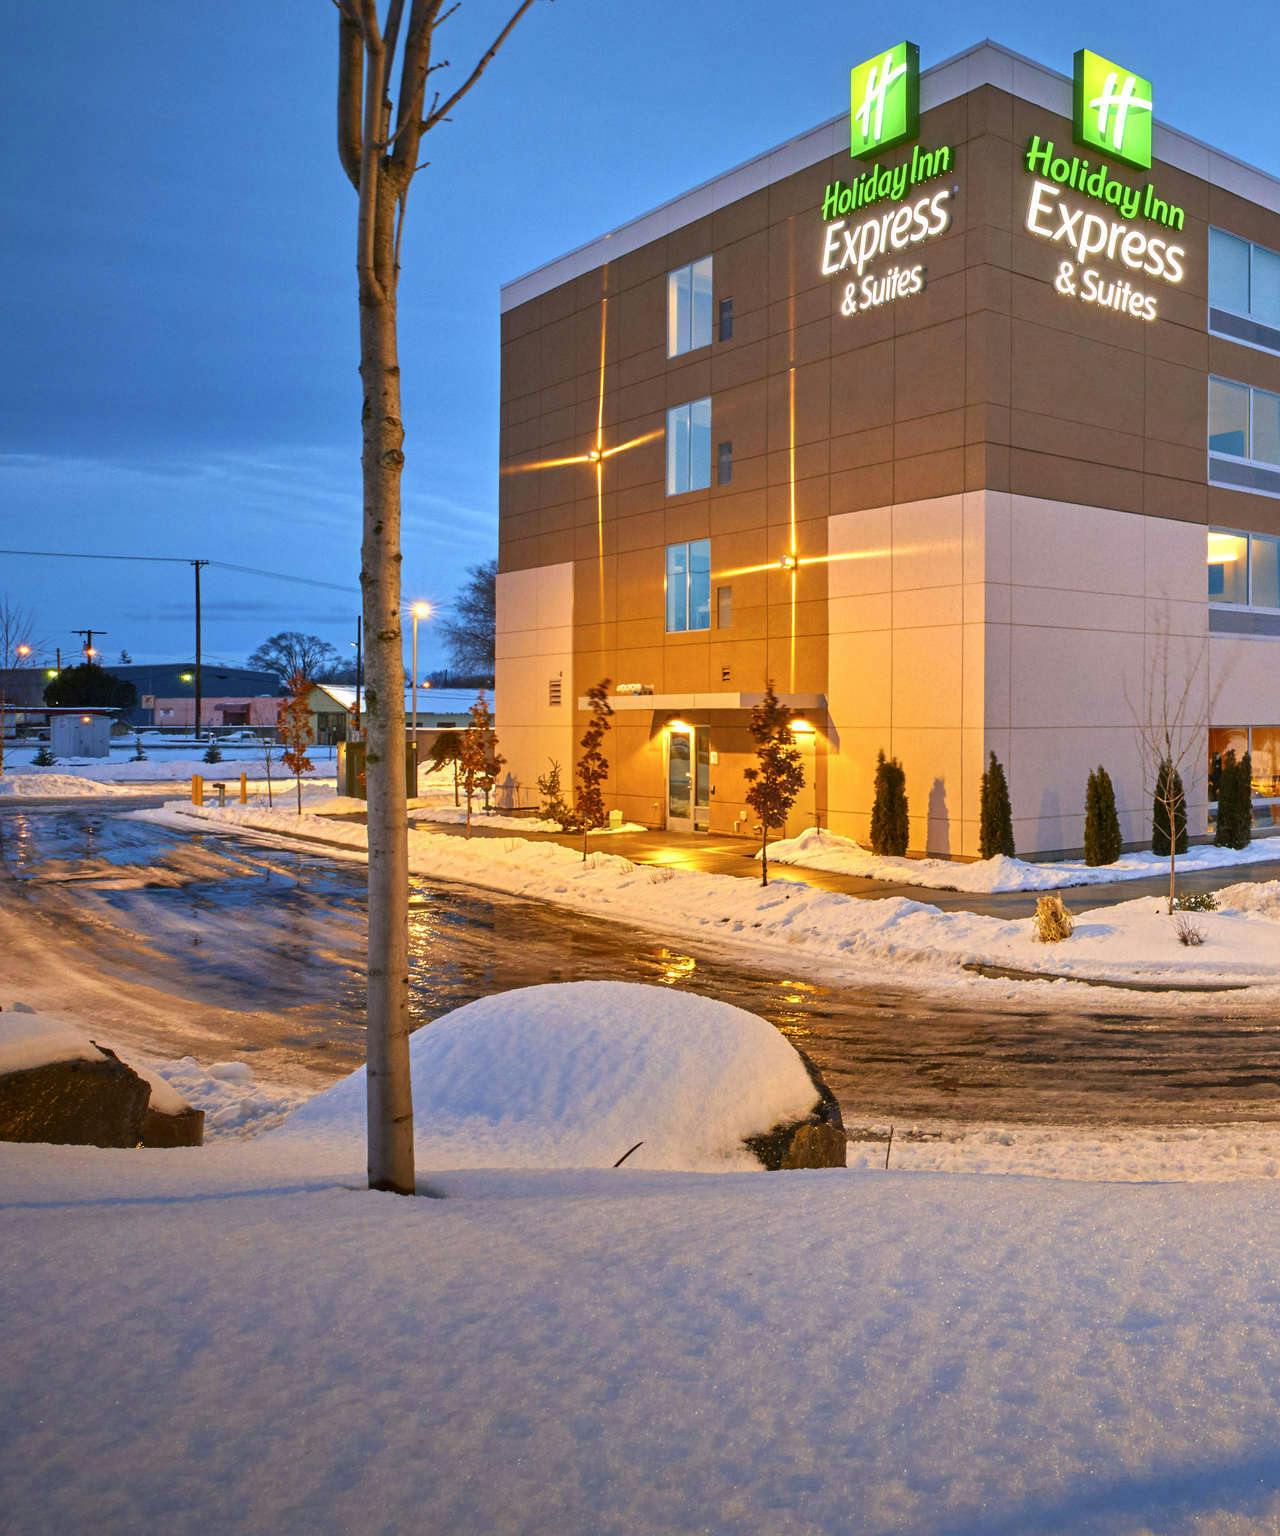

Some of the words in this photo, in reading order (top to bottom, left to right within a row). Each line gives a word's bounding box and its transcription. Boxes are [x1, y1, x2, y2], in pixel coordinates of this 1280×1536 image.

[855, 53, 907, 141] H
[1089, 72, 1152, 150] H
[822, 163, 908, 221] Holiday
[910, 145, 951, 185] Inn
[1026, 135, 1141, 219] Holiday
[1144, 183, 1185, 231] Inn
[821, 190, 950, 277] Express
[1026, 180, 1185, 283] Express
[840, 283, 858, 316] &
[859, 265, 923, 310] Suites
[1055, 261, 1076, 295] &
[1080, 269, 1157, 321] Suites
